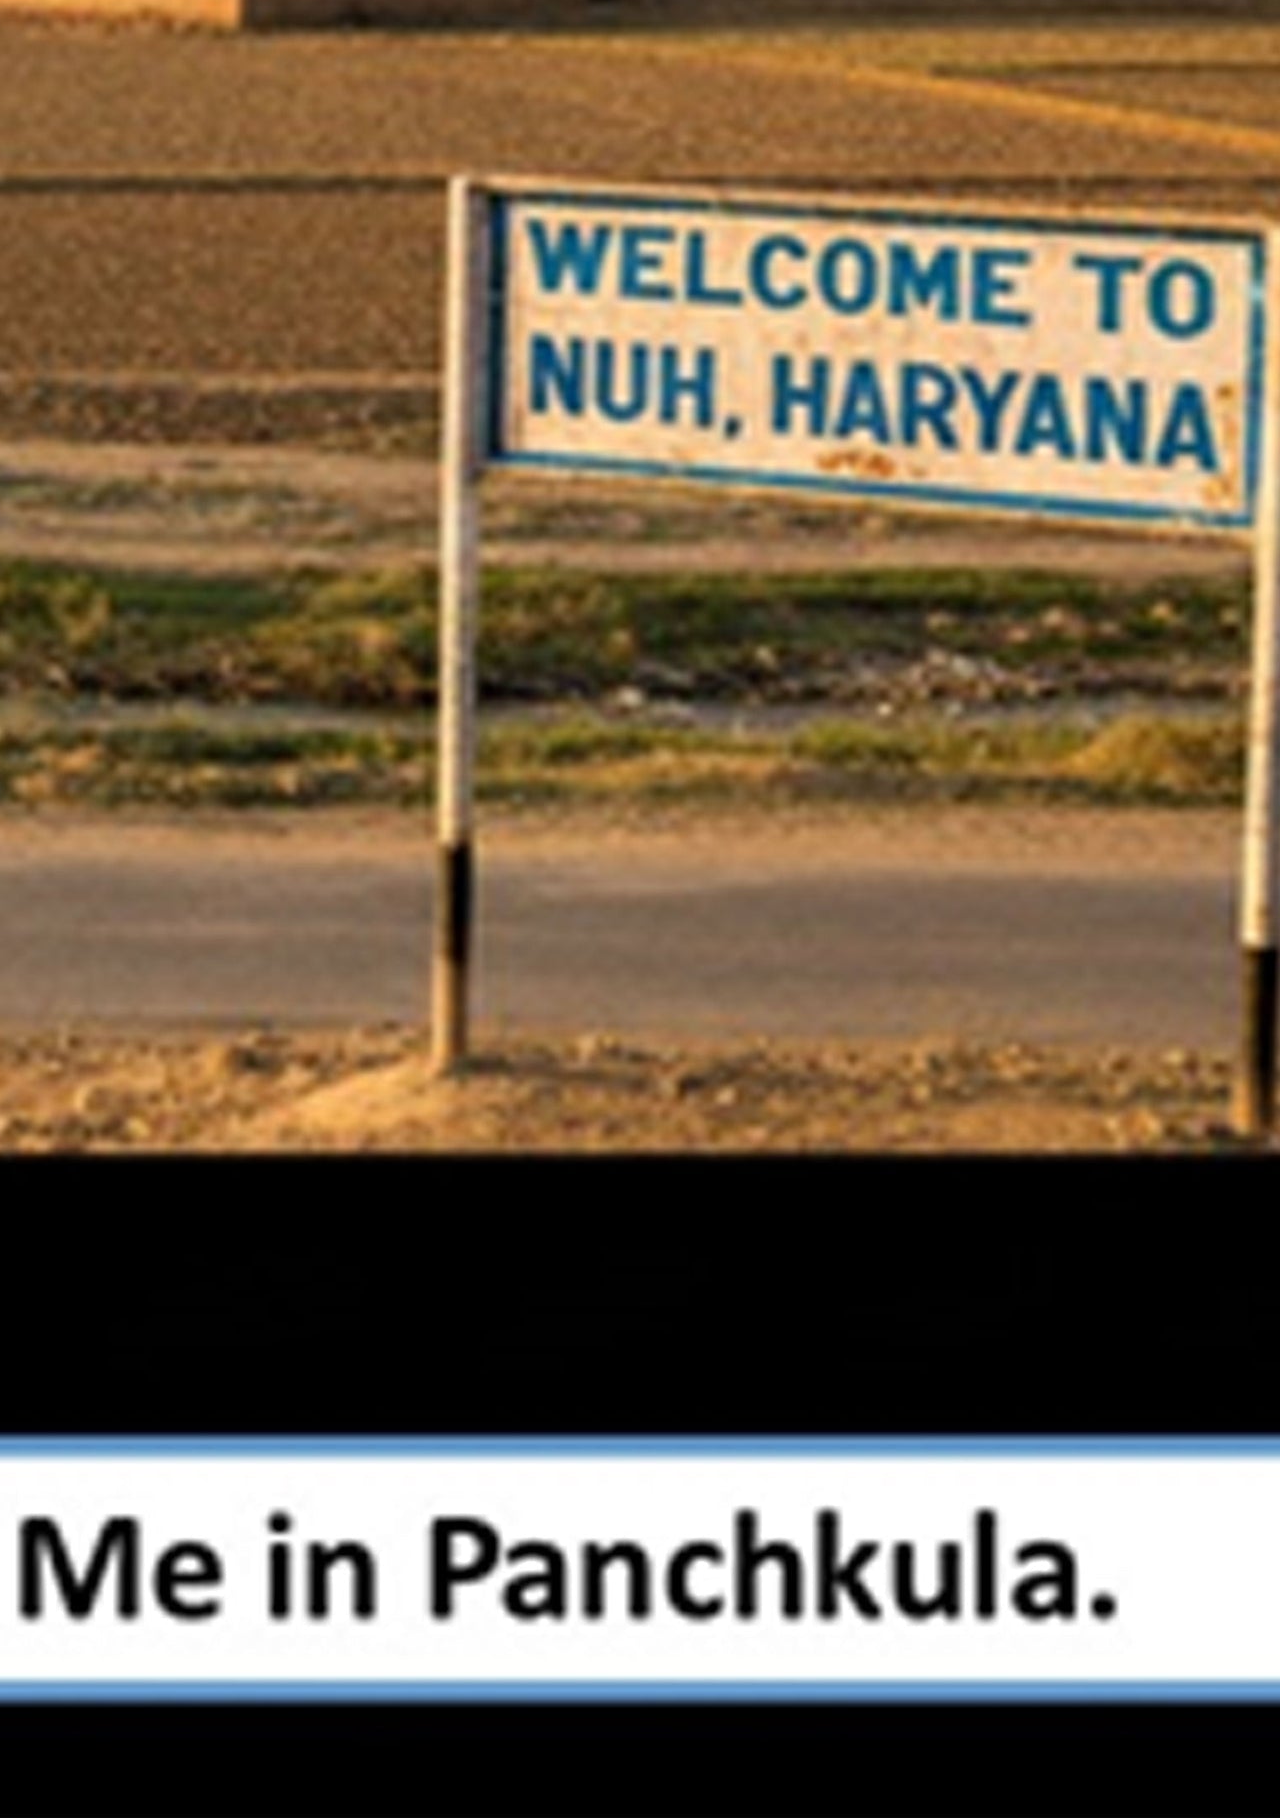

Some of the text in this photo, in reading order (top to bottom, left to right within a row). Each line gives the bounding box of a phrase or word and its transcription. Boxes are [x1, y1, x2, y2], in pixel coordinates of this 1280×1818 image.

[527, 219, 1216, 340] WELCOME TO
[529, 334, 1220, 473] NUH, HARYANA
